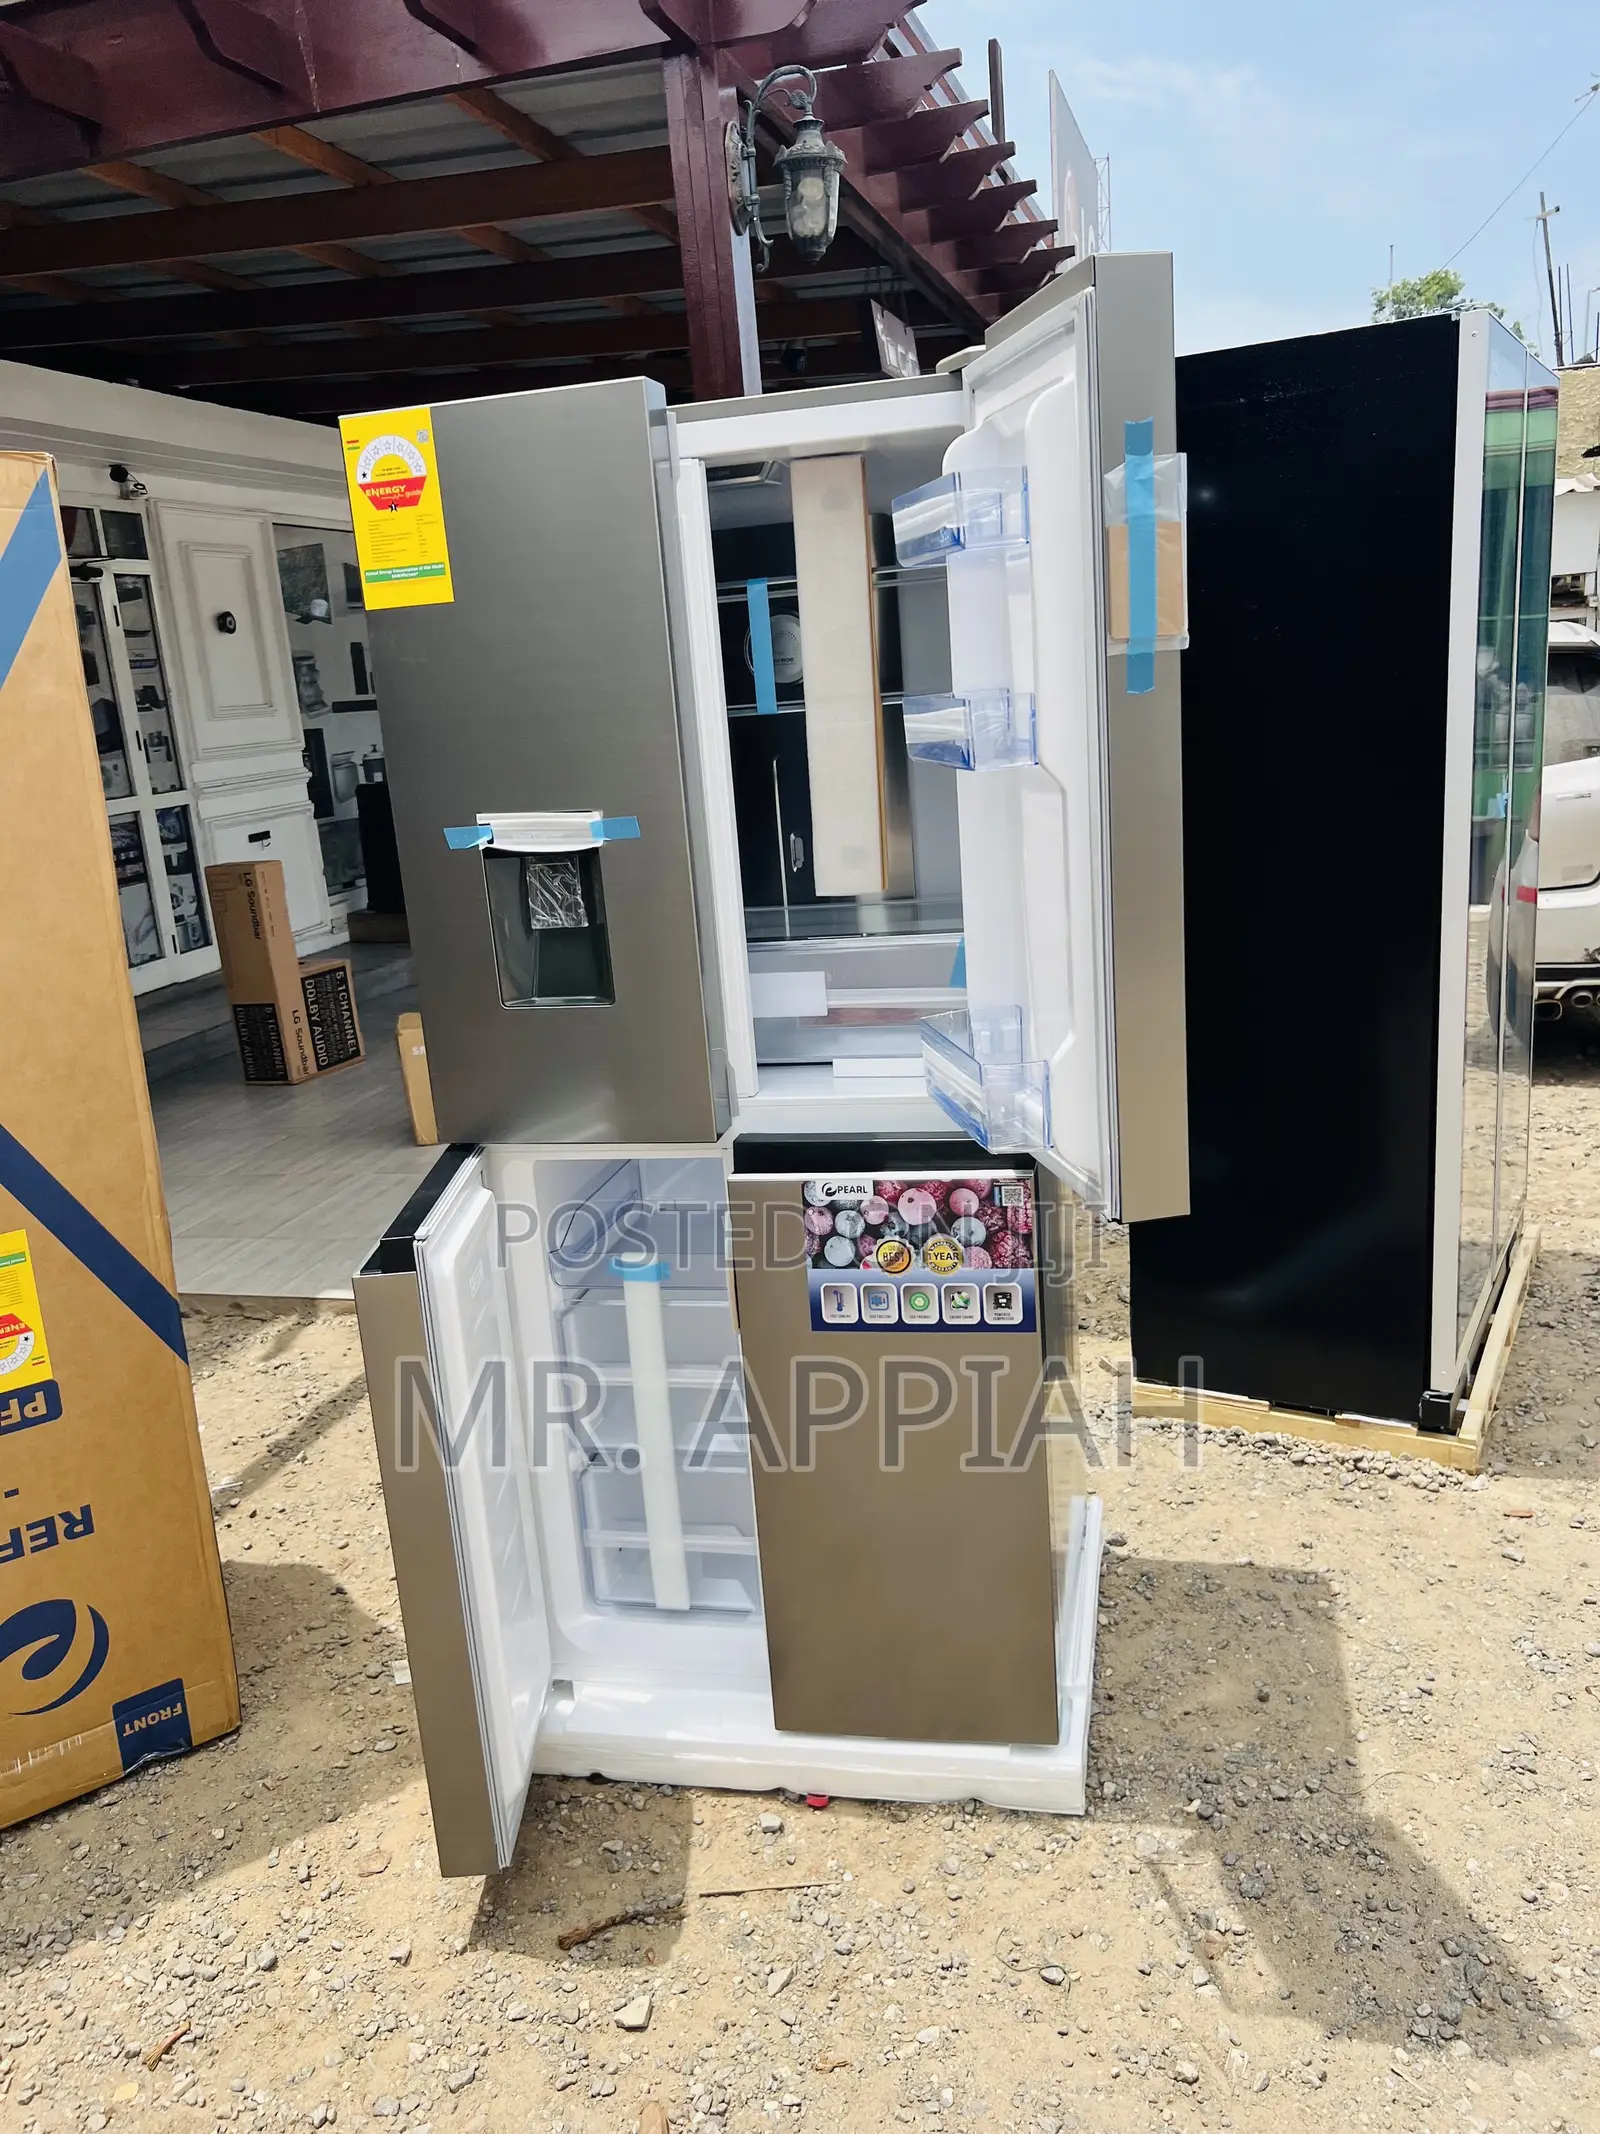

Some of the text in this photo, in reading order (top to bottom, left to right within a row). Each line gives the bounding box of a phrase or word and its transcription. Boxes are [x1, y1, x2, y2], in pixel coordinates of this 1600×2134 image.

[365, 484, 407, 497] ENERGY
[243, 872, 262, 940] LG Soundbar
[304, 979, 321, 1021] DOLBY
[291, 1010, 310, 1076] LG Soundbar
[312, 1026, 329, 1066] AUDIO
[836, 1184, 868, 1195] PEARL
[883, 1252, 904, 1262] BEST
[933, 1252, 959, 1260] YEAR
[122, 1702, 183, 1737] FRONT
